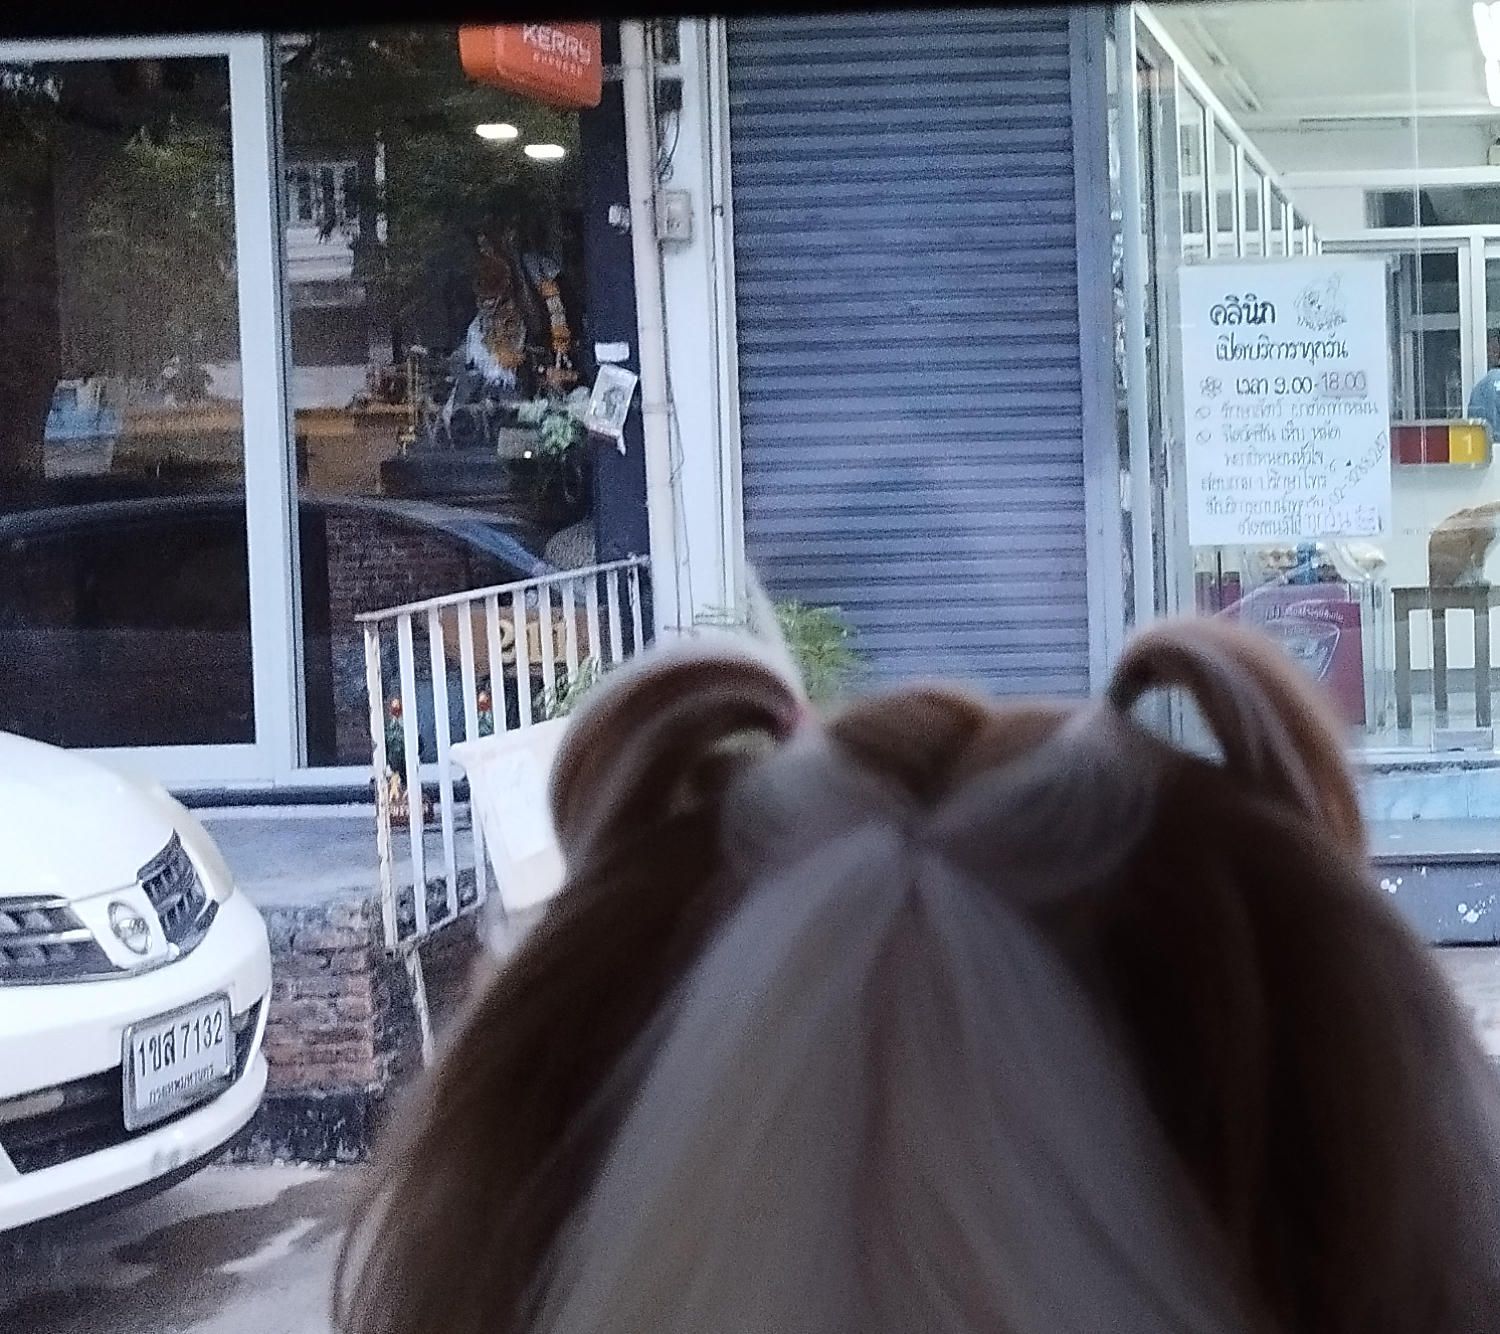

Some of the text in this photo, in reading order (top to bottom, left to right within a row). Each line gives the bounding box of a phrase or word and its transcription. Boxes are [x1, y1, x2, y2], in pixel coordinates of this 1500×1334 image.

[523, 23, 590, 65] KERRY
[1210, 293, 1276, 326] คลินิก
[1216, 332, 1349, 366] เปิดบริการทุกวัน
[1236, 376, 1269, 395] เวลา
[180, 1010, 223, 1059] 7132
